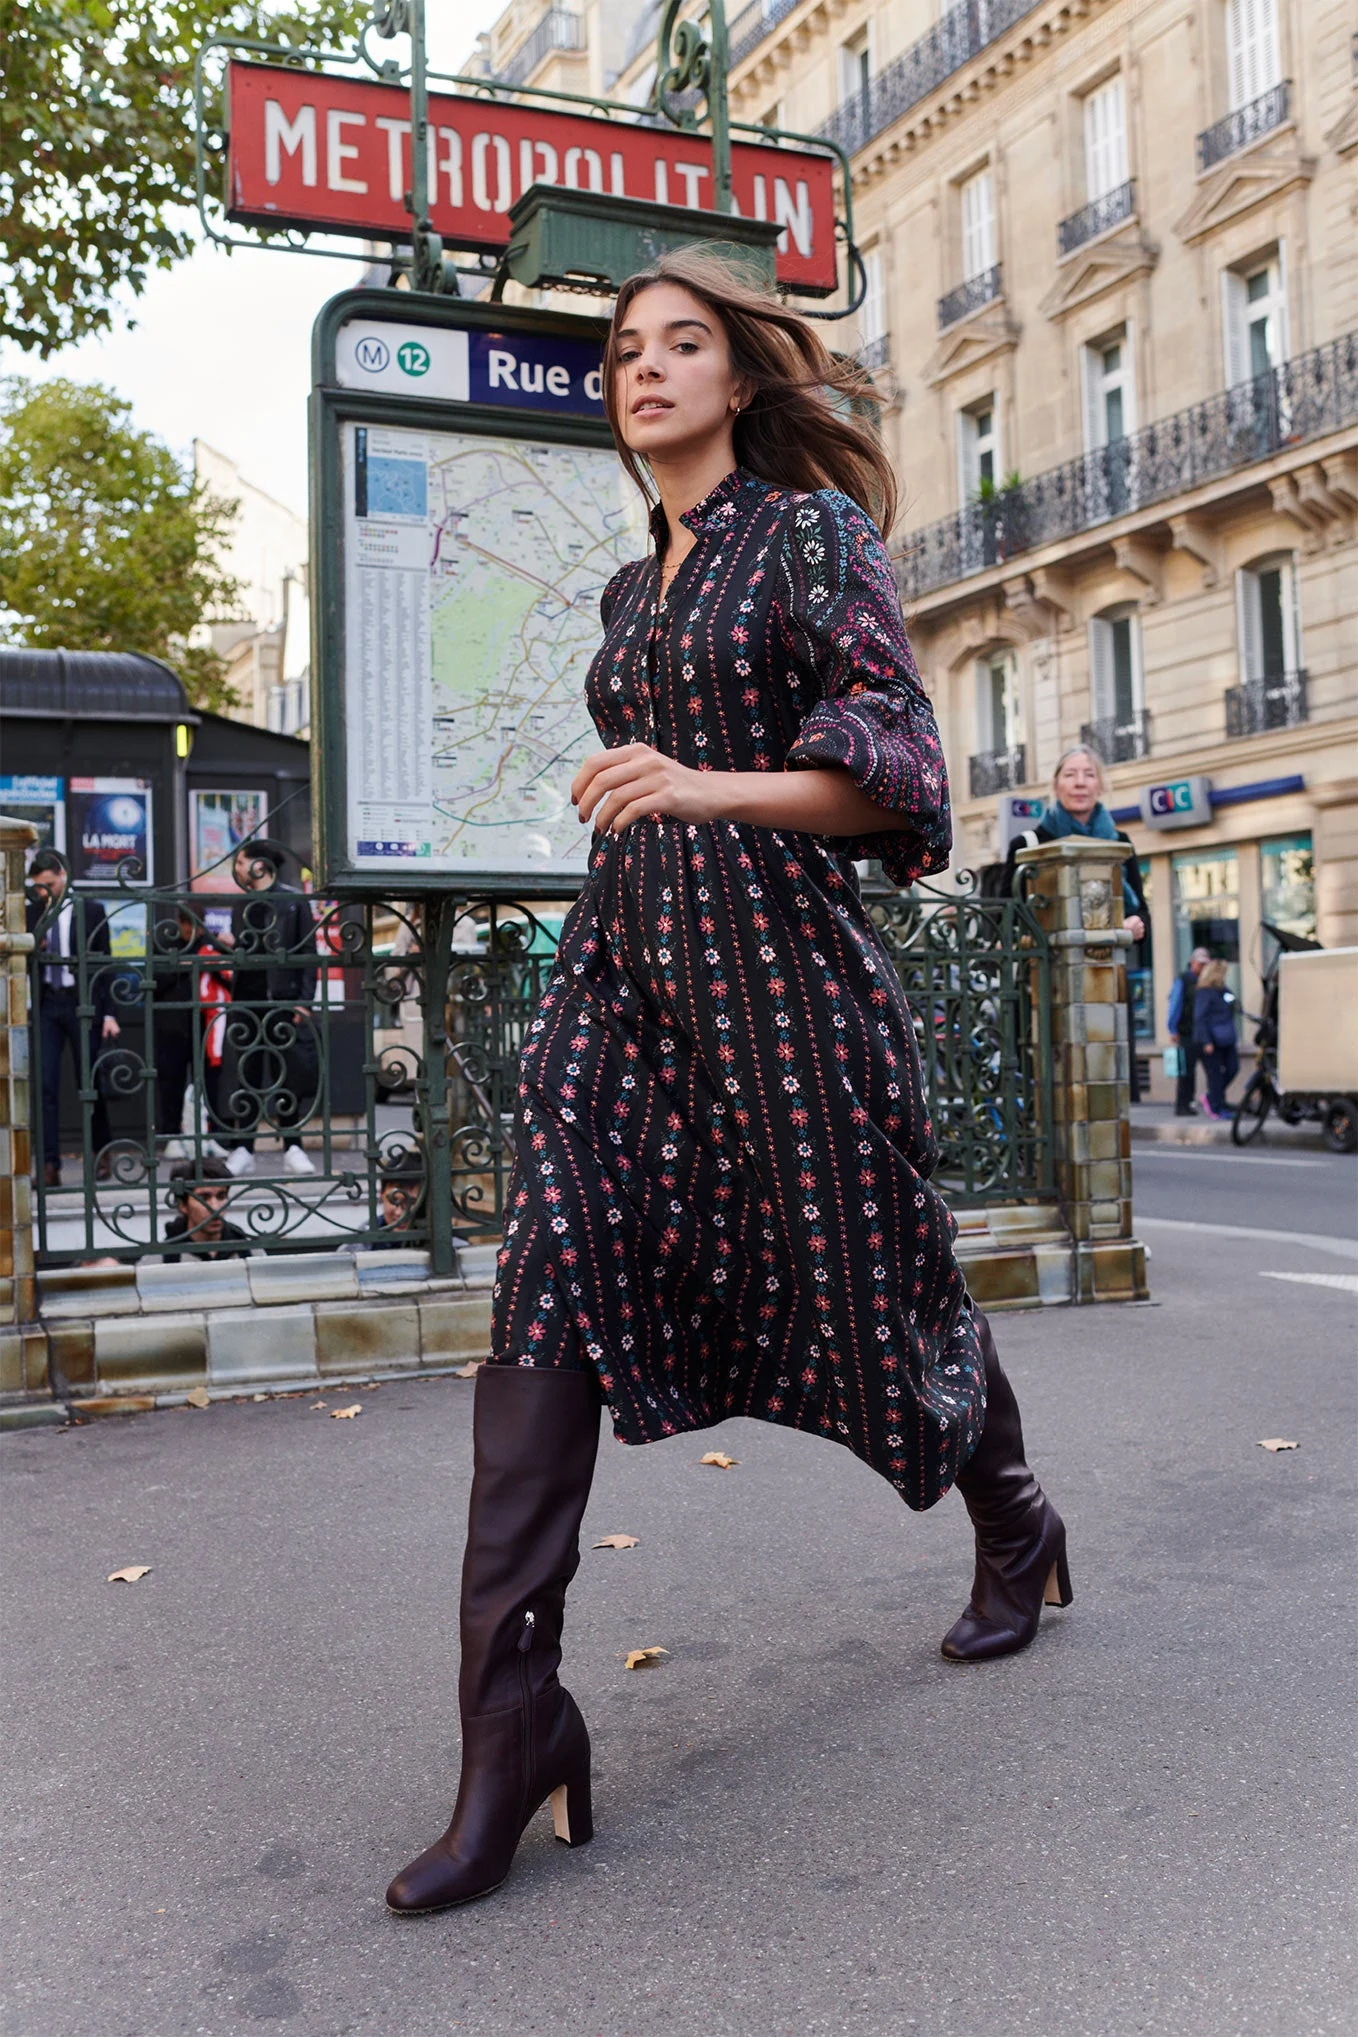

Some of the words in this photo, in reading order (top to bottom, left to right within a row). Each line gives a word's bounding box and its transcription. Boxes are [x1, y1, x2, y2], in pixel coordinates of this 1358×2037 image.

[264, 99, 815, 259] METROPOLITIN
[399, 347, 427, 373] 12
[488, 350, 571, 396] Rue
[1152, 784, 1190, 812] CIC
